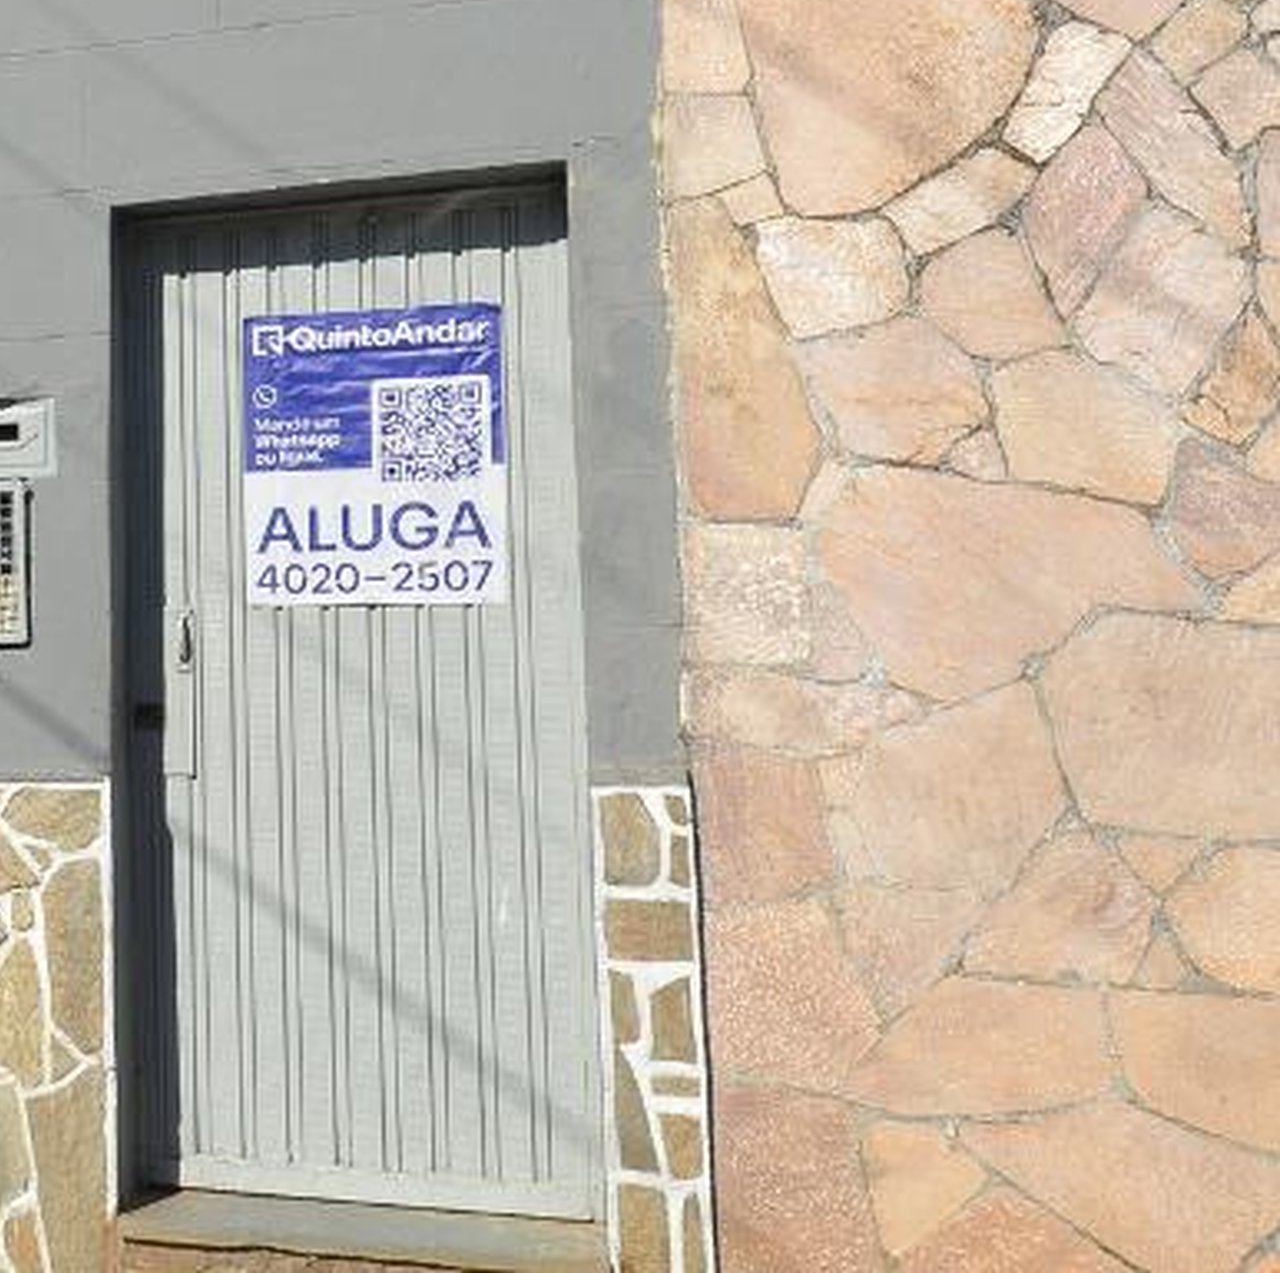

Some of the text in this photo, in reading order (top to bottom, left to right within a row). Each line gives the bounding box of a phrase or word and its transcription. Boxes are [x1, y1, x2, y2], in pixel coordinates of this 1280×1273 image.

[290, 318, 490, 352] QuintoAndar
[257, 500, 493, 554] ALUGA
[257, 560, 494, 595] 4020-2507
